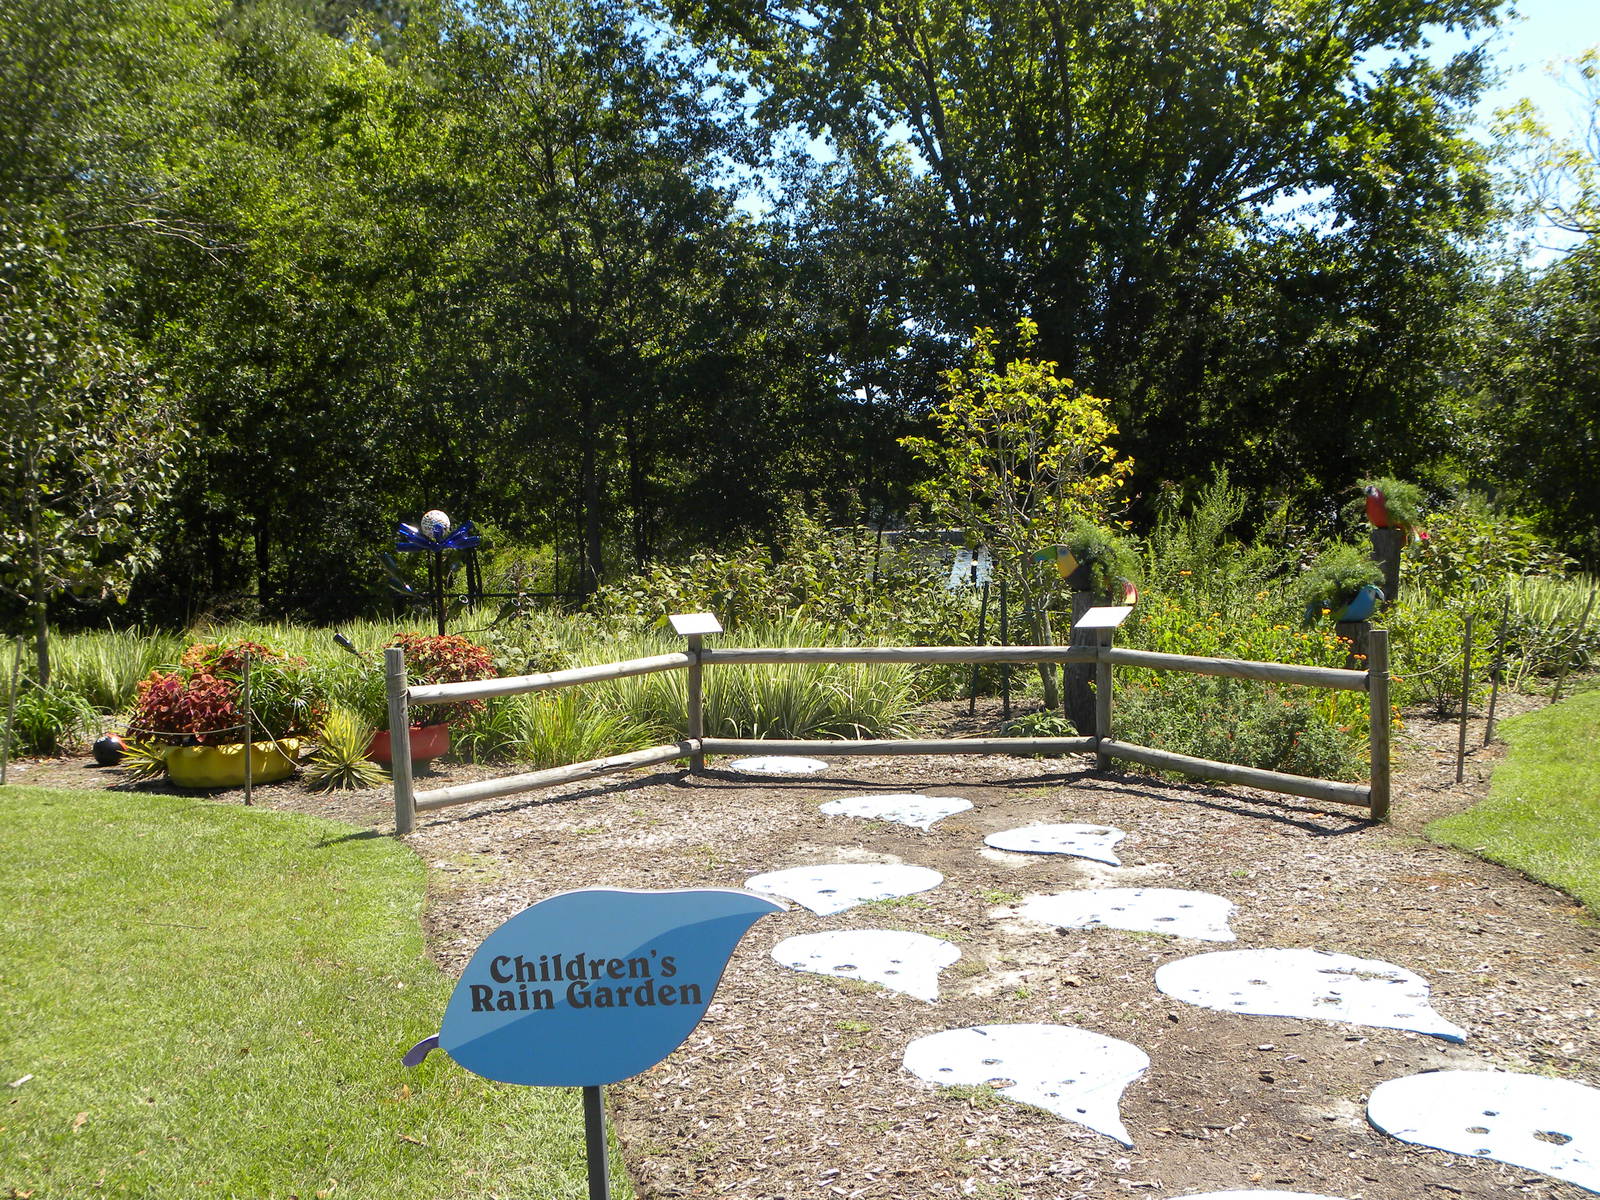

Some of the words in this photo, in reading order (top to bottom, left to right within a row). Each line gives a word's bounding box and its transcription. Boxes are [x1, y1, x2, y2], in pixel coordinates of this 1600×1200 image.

[490, 950, 677, 984] Children's
[469, 984, 555, 1012] Rain
[566, 979, 702, 1009] Garden
